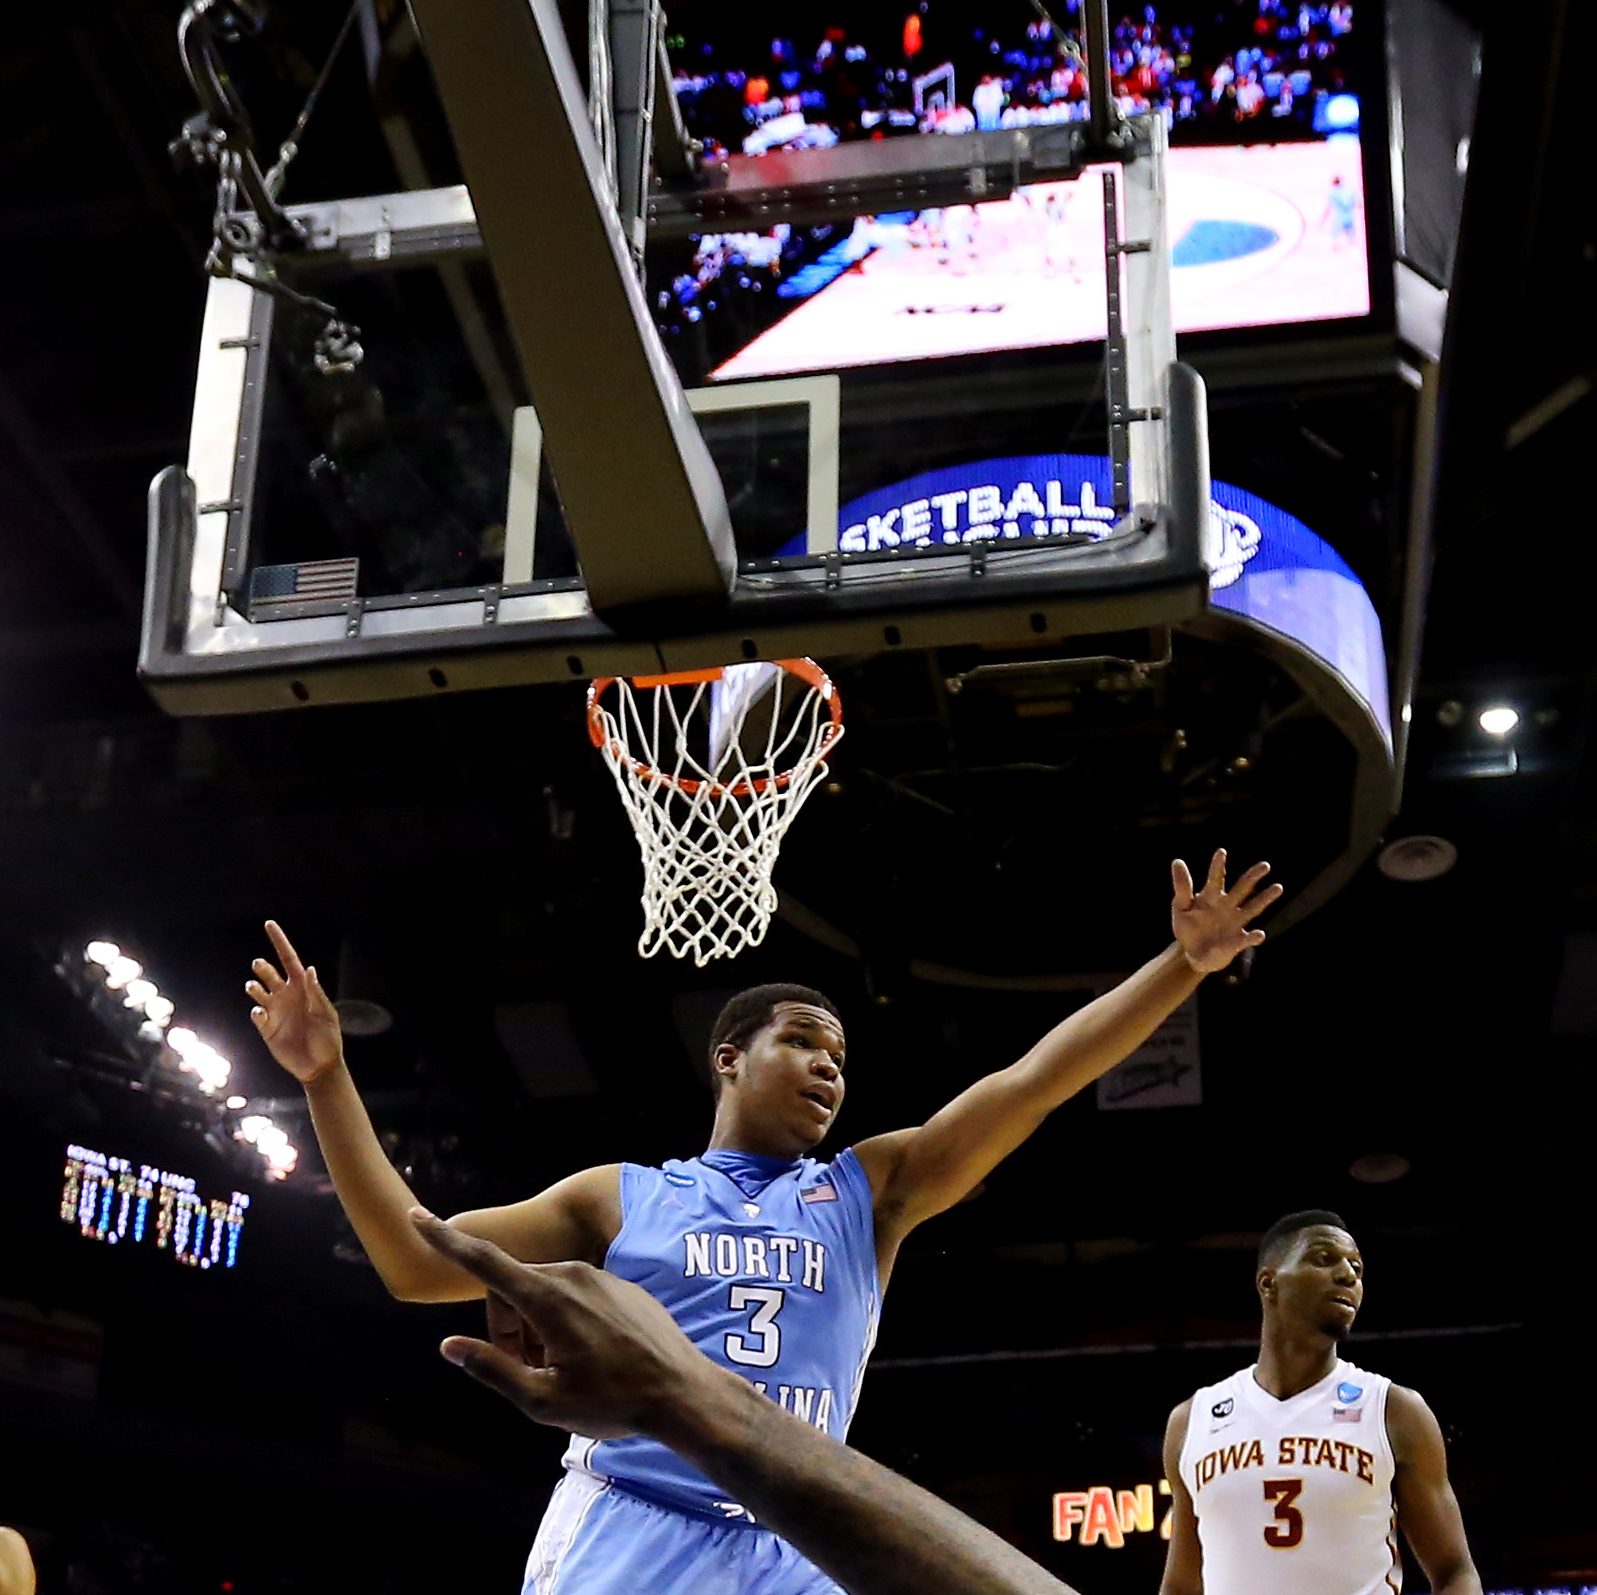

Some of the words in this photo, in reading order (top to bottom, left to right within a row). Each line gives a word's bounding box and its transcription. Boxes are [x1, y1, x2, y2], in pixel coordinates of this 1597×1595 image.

[684, 1232, 827, 1293] NORTH
[724, 1284, 785, 1368] 3
[1195, 1439, 1264, 1493] IOWA
[1278, 1436, 1374, 1487] STATE
[1263, 1479, 1305, 1550] 3
